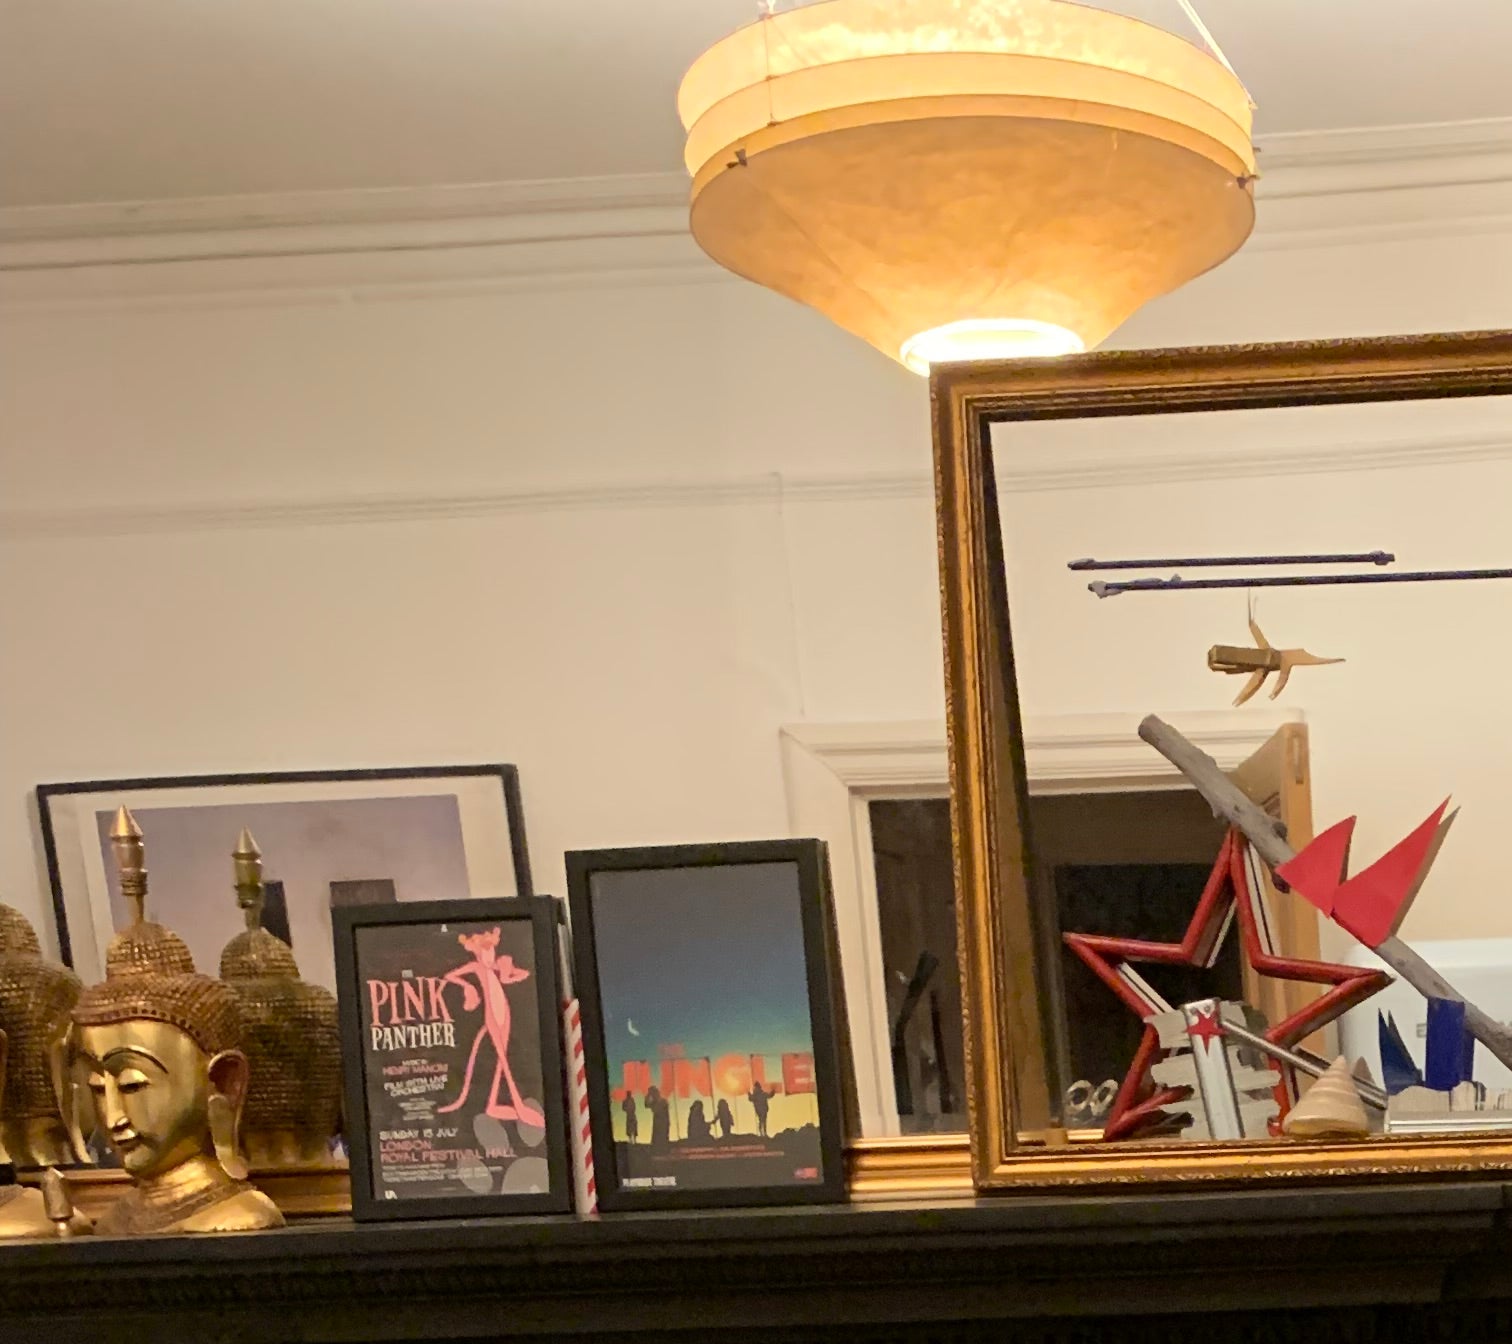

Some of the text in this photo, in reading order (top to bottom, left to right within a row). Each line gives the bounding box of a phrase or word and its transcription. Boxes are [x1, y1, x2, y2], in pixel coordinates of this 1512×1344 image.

[366, 976, 455, 1027] PINK
[371, 1022, 456, 1051] PANTHER
[611, 1052, 815, 1102] JUNGLE
[379, 1128, 419, 1140] SUNDAY
[436, 1127, 458, 1138] JULY
[380, 1140, 432, 1152] LONDON
[381, 1147, 517, 1164] ROYAL FESTIVAL HALL
